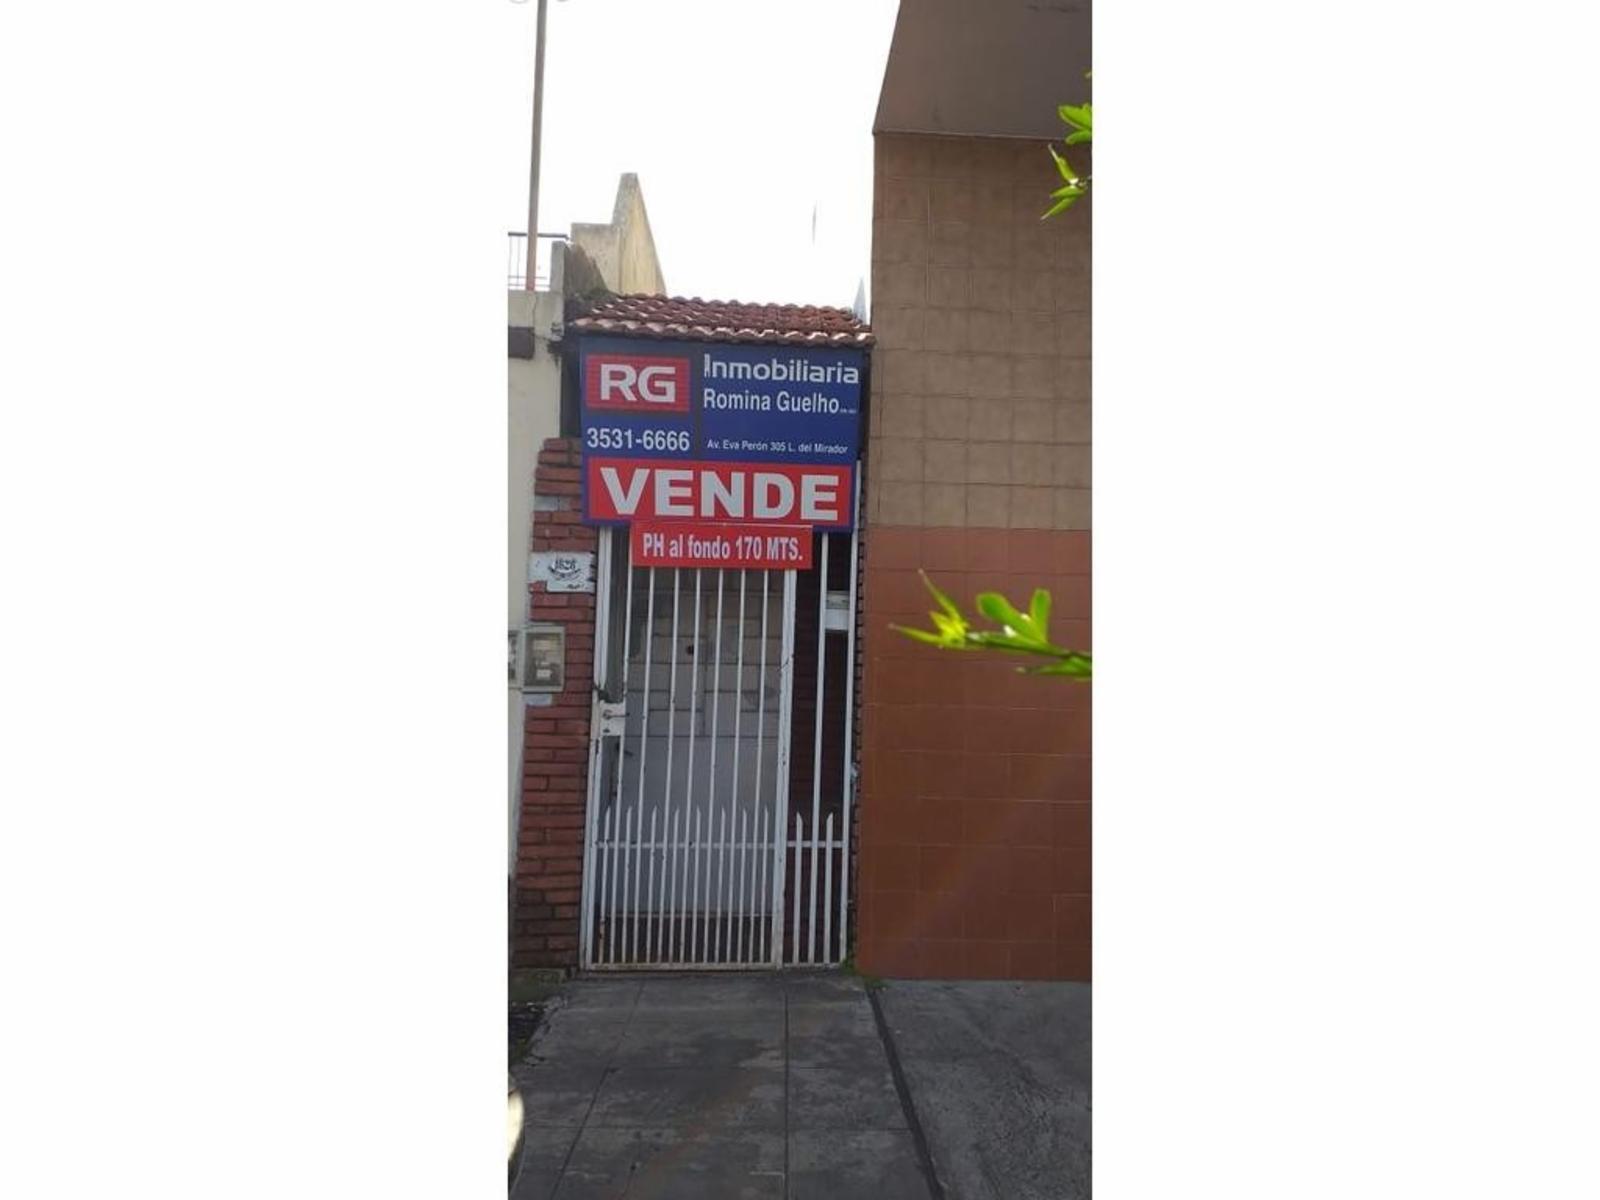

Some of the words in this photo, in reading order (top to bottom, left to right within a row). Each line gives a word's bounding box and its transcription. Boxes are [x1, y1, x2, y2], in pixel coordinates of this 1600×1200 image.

[704, 353, 859, 383] Inmobiliaria
[600, 363, 676, 403] RG
[704, 388, 771, 411] Romina
[776, 391, 840, 414] Guelho
[587, 427, 690, 451] 3531-6666
[707, 439, 721, 449] Av.
[722, 439, 740, 450] Eva
[741, 440, 768, 451] Perón
[769, 442, 786, 451] 305
[787, 443, 796, 452] L.
[798, 443, 812, 453] del
[814, 443, 849, 454] Mirador
[600, 467, 840, 521] VENDE
[642, 533, 665, 557] PH
[669, 535, 684, 557] al
[687, 534, 731, 560] fondo
[735, 537, 763, 561] 170
[766, 537, 804, 561] MTS.
